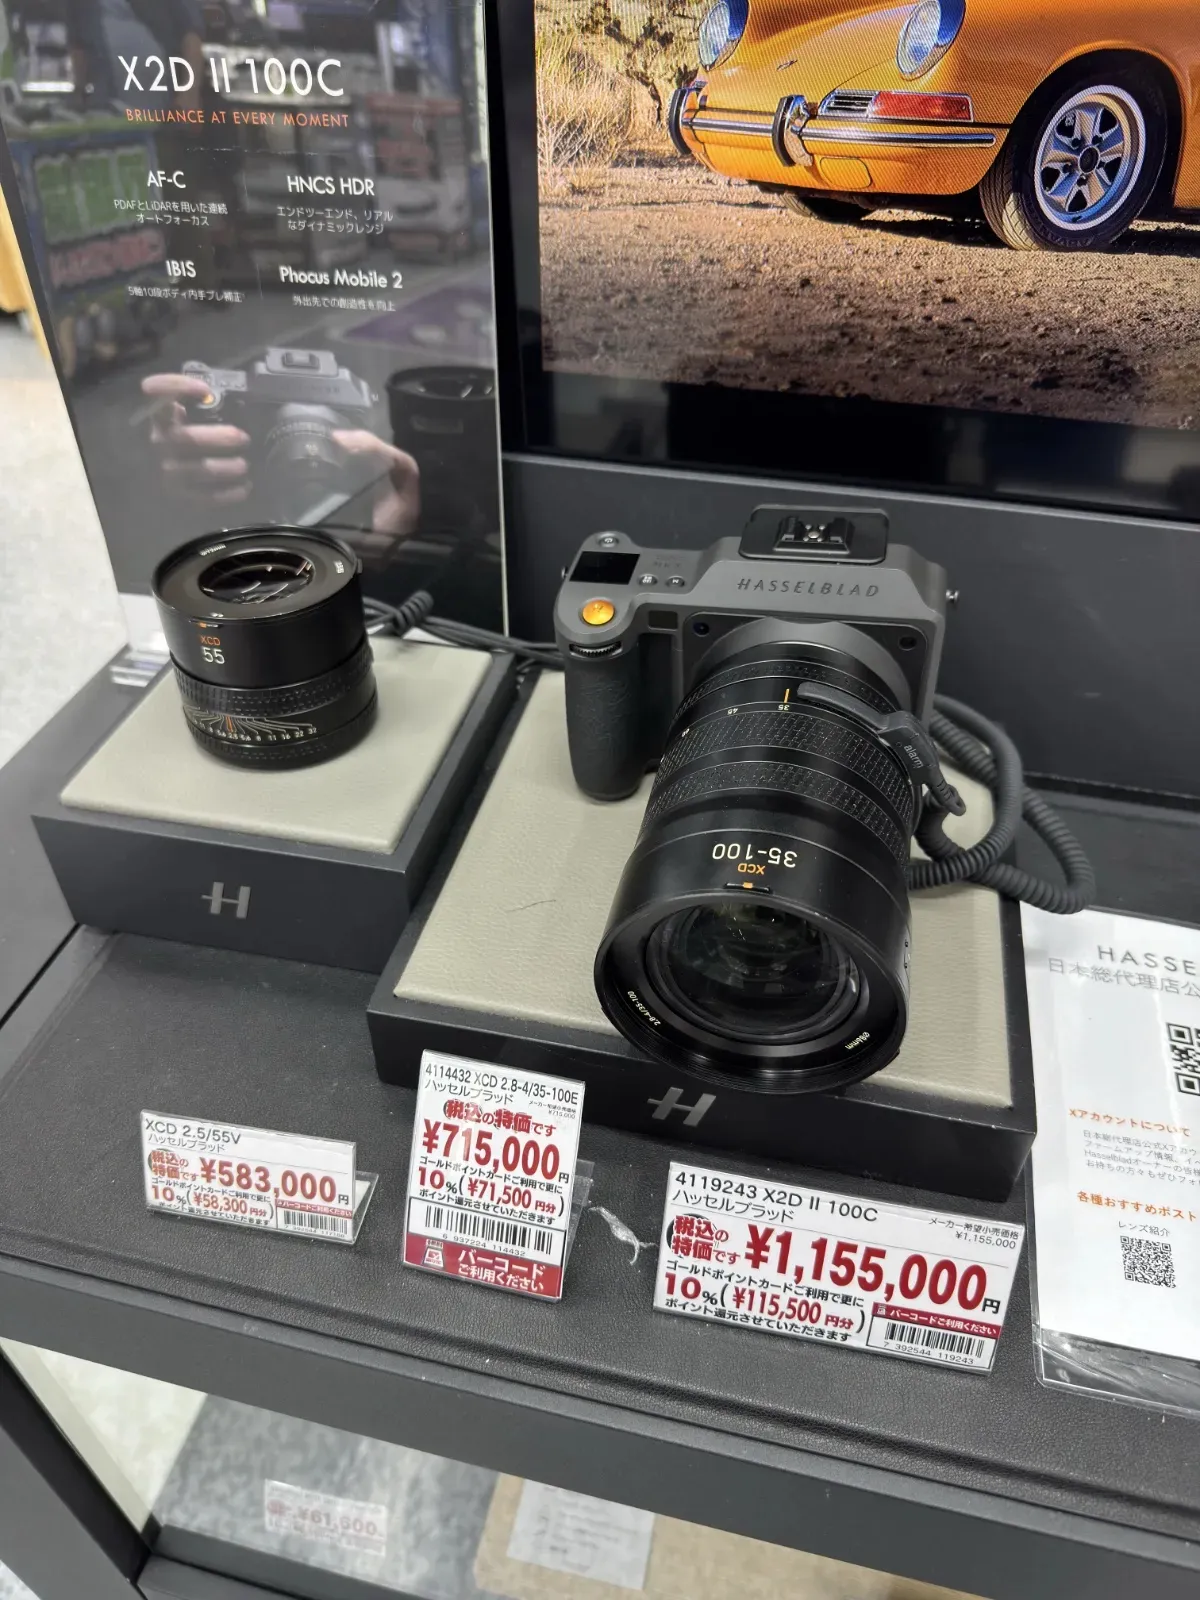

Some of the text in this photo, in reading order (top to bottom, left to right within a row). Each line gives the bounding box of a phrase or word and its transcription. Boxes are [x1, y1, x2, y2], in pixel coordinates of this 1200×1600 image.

[118, 55, 344, 97] X2D II 100C
[126, 108, 349, 128] BRILLIANCE AT EVERY MOMENT
[146, 170, 187, 189] AF-C
[287, 175, 375, 196] HNCS HDR
[113, 199, 229, 215] PDAFとLiDARを用いた連続
[277, 206, 394, 222] エンドツーエンド、リアル
[136, 213, 209, 226] オートフォーカス
[287, 219, 384, 235] なダイナミックレンジ
[165, 259, 196, 278] IBIS
[279, 265, 403, 289] Phocus Mobile 2
[736, 577, 881, 599] HASSELBLAD
[200, 635, 221, 646] XCD
[202, 646, 226, 665] 55
[712, 843, 798, 868] 35-100
[737, 862, 766, 875] XCD
[1097, 945, 1198, 976] HASSE
[425, 1062, 578, 1105] 4114432 XCD 2.8-4/35-100E
[425, 1079, 513, 1105] ハッセルブラッド
[445, 1098, 557, 1137] 税込の特価です
[1068, 1108, 1191, 1138] Xアカウントについて
[145, 1117, 242, 1145] XCD 2.5/55V
[148, 1133, 225, 1153] ハッセルブラッド
[150, 1150, 189, 1168] 税込の
[151, 1163, 199, 1182] 特価です
[419, 1155, 563, 1195] ゴールドポイントカードご利用で更に
[419, 1188, 555, 1225] ポイント還元させていただきます
[672, 1189, 794, 1223] ハッセルブラッド
[675, 1171, 757, 1199] 4119243
[763, 1187, 803, 1207] X2D
[828, 1201, 878, 1222] 100C
[1076, 1190, 1197, 1222] 各種おすすめポスト
[673, 1215, 729, 1242] 税込の
[929, 1217, 1019, 1240] メーカー希望小売価格
[955, 1230, 1016, 1250] ¥1,155,000
[1118, 1220, 1170, 1238] レンズ紹介
[453, 1235, 487, 1248] 937224
[492, 1244, 526, 1257] 114432
[671, 1235, 741, 1265] 特価です
[457, 1249, 546, 1280] バーコード
[457, 1264, 544, 1292] ご利用ください
[666, 1259, 864, 1308] ゴールドポイントカードご利用で更に
[665, 1298, 851, 1342] ポイント還元させていただきます
[890, 1309, 996, 1335] バーコードご利用ください
[894, 1344, 931, 1357] 392544
[938, 1351, 974, 1365] 119243
